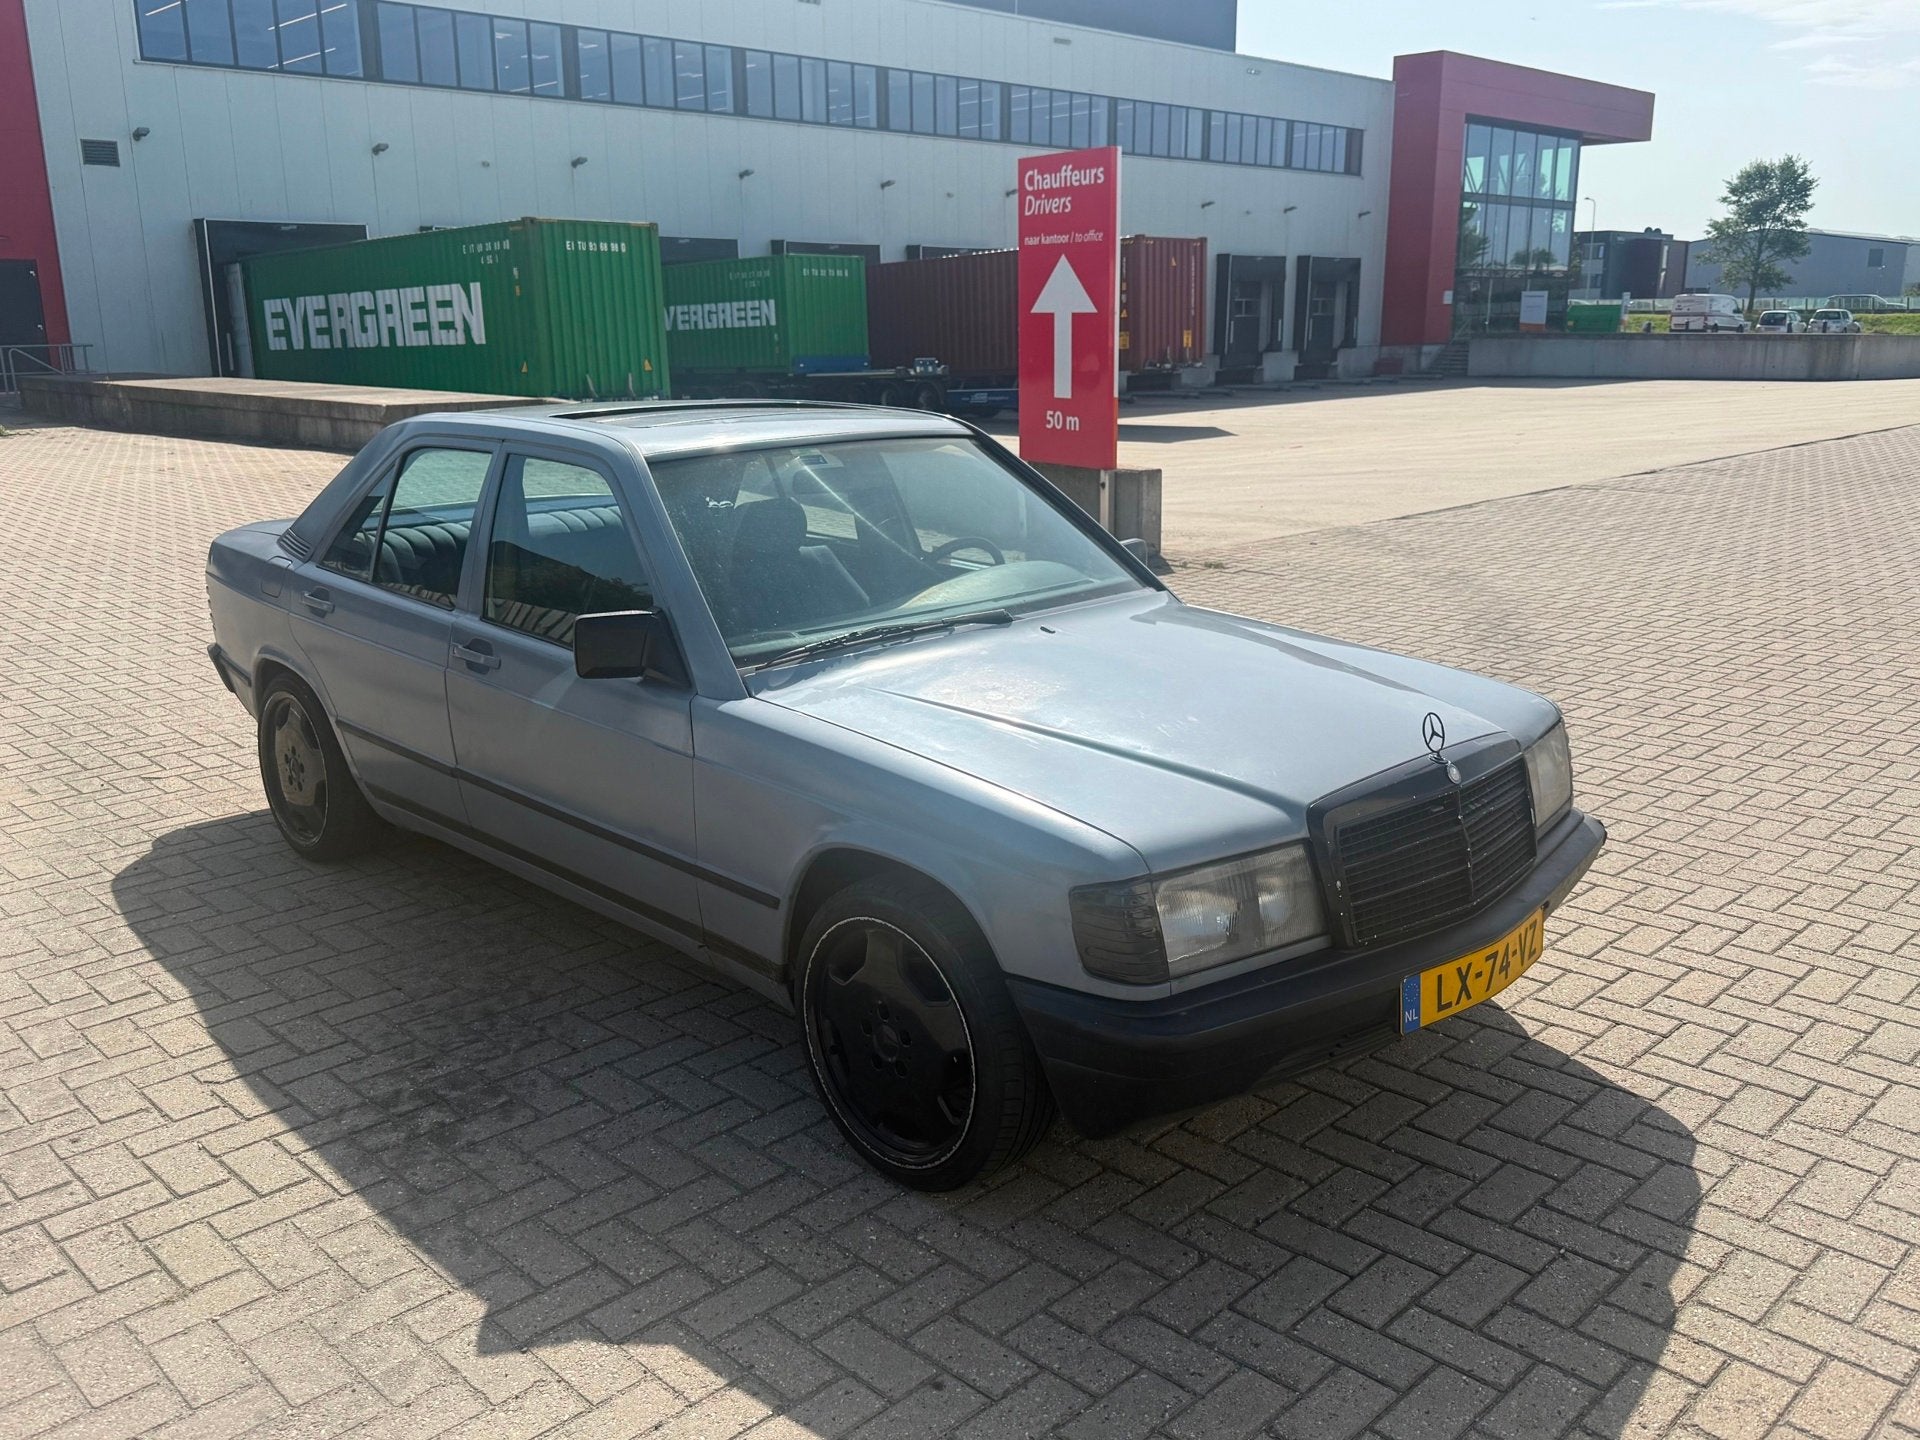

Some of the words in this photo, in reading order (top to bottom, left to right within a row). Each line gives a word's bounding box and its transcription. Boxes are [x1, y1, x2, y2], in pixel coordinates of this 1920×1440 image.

[1024, 164, 1104, 191] Chauffeurs
[1024, 194, 1072, 216] Drivers
[1024, 236, 1040, 246] naar
[1041, 233, 1069, 245] kantoor
[1075, 232, 1083, 242] to
[1083, 229, 1103, 242] office
[264, 282, 486, 350] EVERGREEN
[664, 299, 777, 331] VERGREEN
[1046, 410, 1063, 430] 50
[1066, 415, 1079, 431] m
[1437, 919, 1538, 1012] LX-74-VZ
[1405, 1009, 1418, 1023] NL
